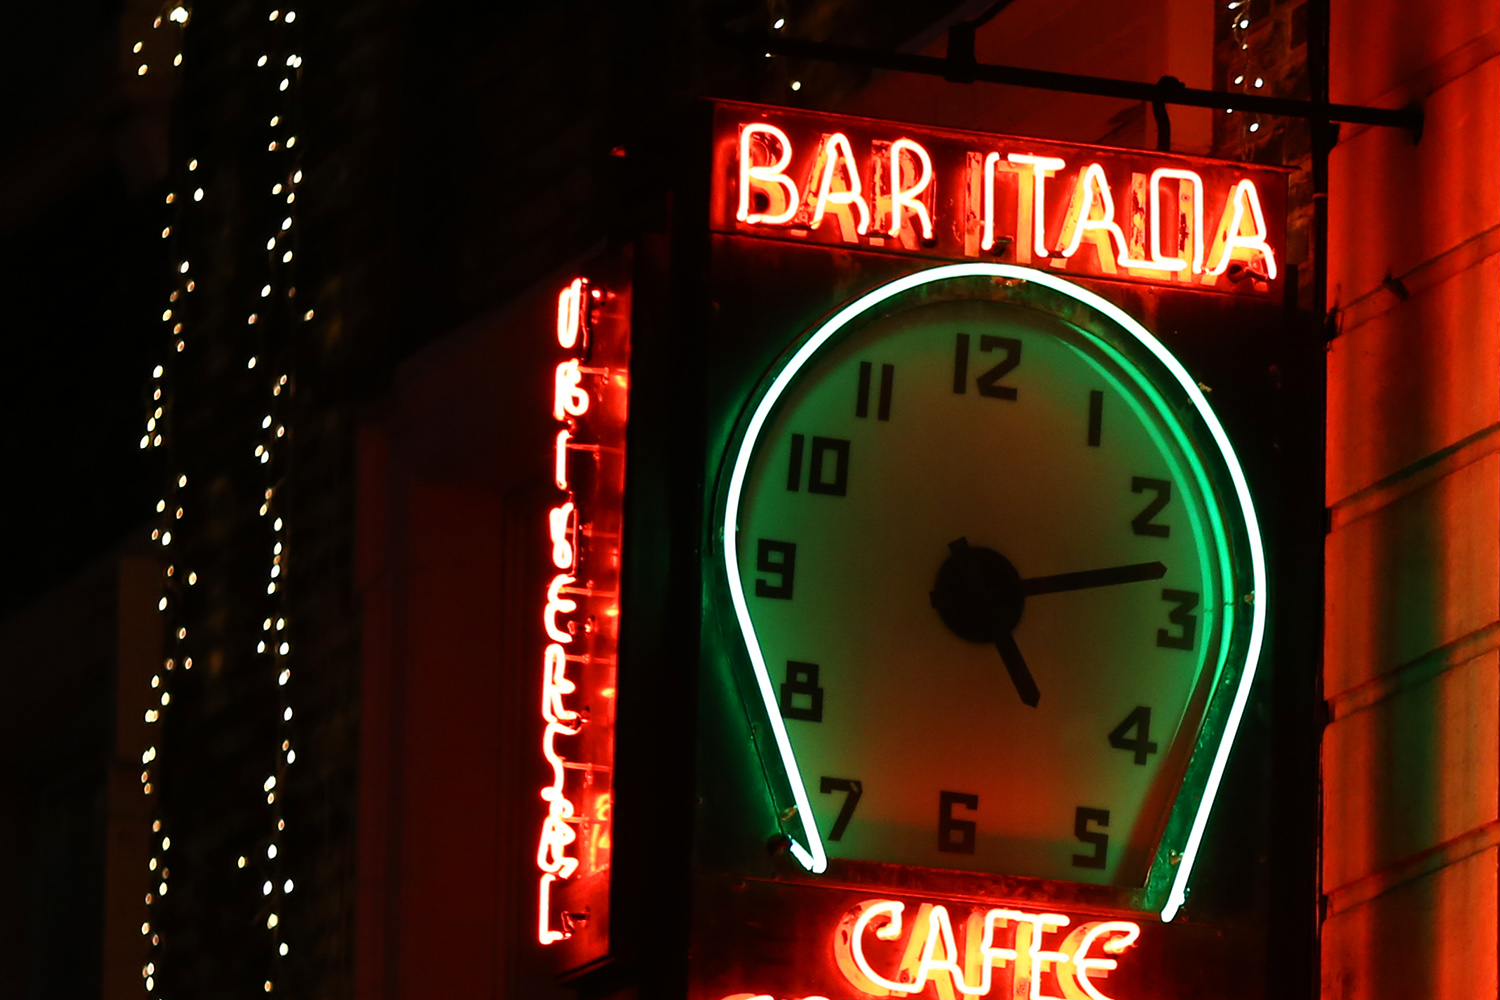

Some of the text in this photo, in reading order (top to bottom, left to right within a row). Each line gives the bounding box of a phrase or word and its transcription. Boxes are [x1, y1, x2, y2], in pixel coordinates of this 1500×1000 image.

[735, 122, 934, 244] BAR
[856, 361, 894, 421] 11
[953, 333, 1022, 401] 12
[1088, 390, 1104, 447] 1
[787, 433, 850, 496] 10
[1131, 476, 1171, 538] 2
[755, 538, 797, 600] 9
[1157, 589, 1199, 651] 3
[781, 660, 824, 723] 8
[1108, 706, 1158, 766] 4
[820, 776, 863, 842] 7
[937, 790, 979, 856] 6
[1072, 806, 1110, 871] 5
